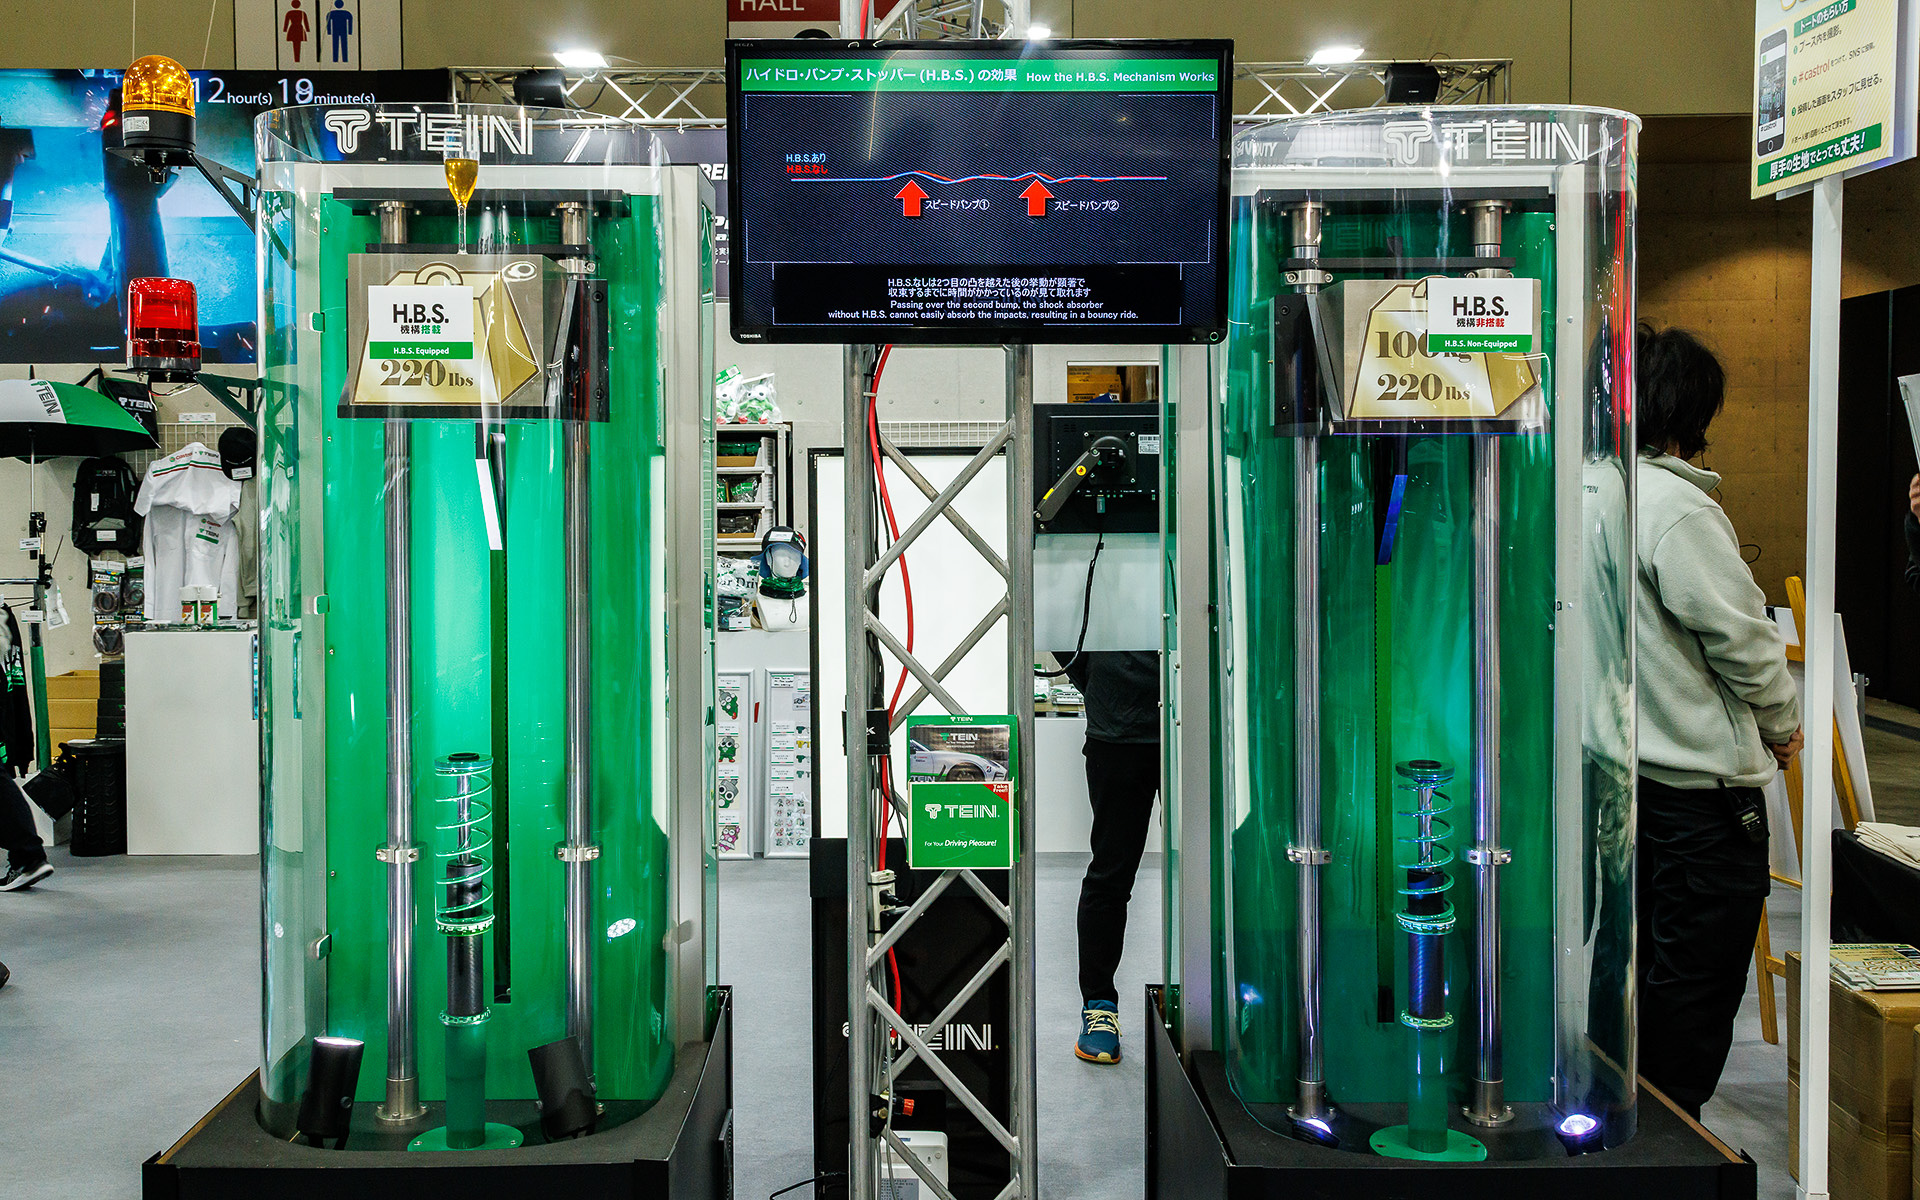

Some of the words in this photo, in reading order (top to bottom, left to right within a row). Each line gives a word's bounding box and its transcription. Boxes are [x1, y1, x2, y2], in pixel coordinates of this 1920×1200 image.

[920, 68, 975, 83] (H.B.S.)
[978, 68, 1017, 82] の効果
[1026, 72, 1051, 82] How
[1054, 72, 1073, 82] the
[1076, 72, 1110, 82] H.B.S.
[1113, 71, 1176, 82] Mechanism
[1179, 71, 1215, 82] Works
[227, 92, 273, 106] hour(s)
[314, 92, 376, 104] minute(s)
[375, 112, 533, 155] TEIN
[1441, 121, 1589, 161] TEIN
[890, 300, 924, 310] Passing
[926, 300, 945, 308] over
[947, 300, 961, 308] the
[963, 300, 994, 308] second
[995, 300, 1021, 310] bump,
[1023, 300, 1037, 308] the
[1039, 300, 1064, 308] shock
[1066, 300, 1104, 308] absorber
[1452, 296, 1509, 316] H.B.S.
[393, 303, 449, 324] H.B.S.
[921, 310, 945, 320] easily
[994, 310, 1029, 320] impacts,
[1031, 310, 1068, 320] resulting
[1087, 310, 1118, 320] bouncy
[400, 324, 441, 335] 機構搭載
[1456, 317, 1505, 328] 機構非搭載
[1445, 340, 1466, 348] H.B.S.
[1467, 340, 1517, 348] Non-Equipped
[416, 347, 450, 356] Equipped
[380, 359, 446, 387] 220
[449, 372, 474, 387] lbs
[1377, 373, 1442, 401] 220
[1445, 386, 1470, 400] lbs
[36, 386, 60, 414] TEIN
[129, 398, 154, 410] TEIN
[944, 804, 997, 818] TEIN
[944, 840, 968, 848] Driving
